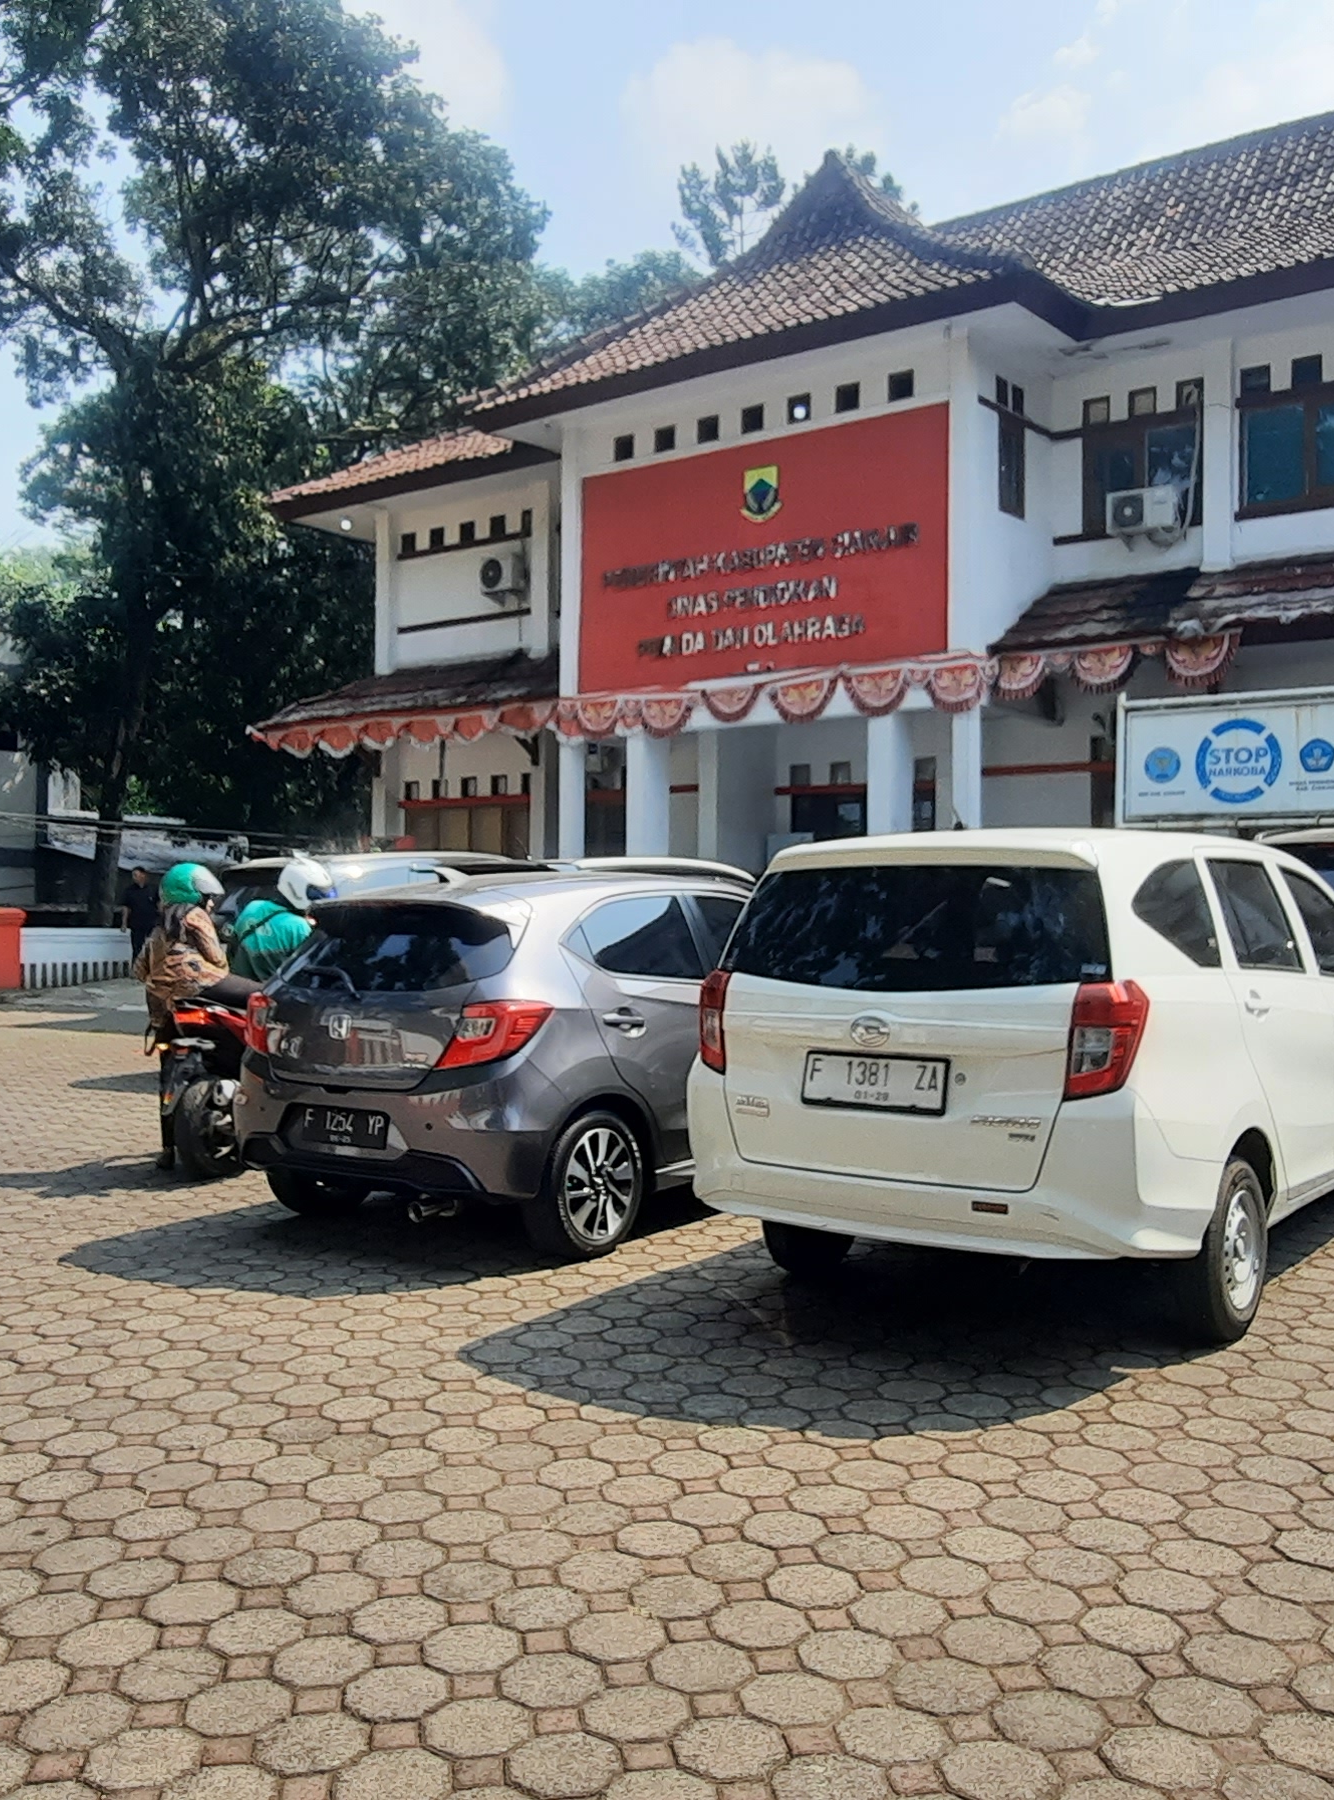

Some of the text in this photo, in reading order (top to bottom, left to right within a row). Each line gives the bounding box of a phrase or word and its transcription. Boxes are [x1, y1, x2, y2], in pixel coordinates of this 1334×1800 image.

[753, 613, 865, 648] OLAHRAGA
[1209, 746, 1269, 765] STOP
[809, 1057, 939, 1092] F 1381 ZA
[304, 1108, 385, 1136] F 1254 YP
